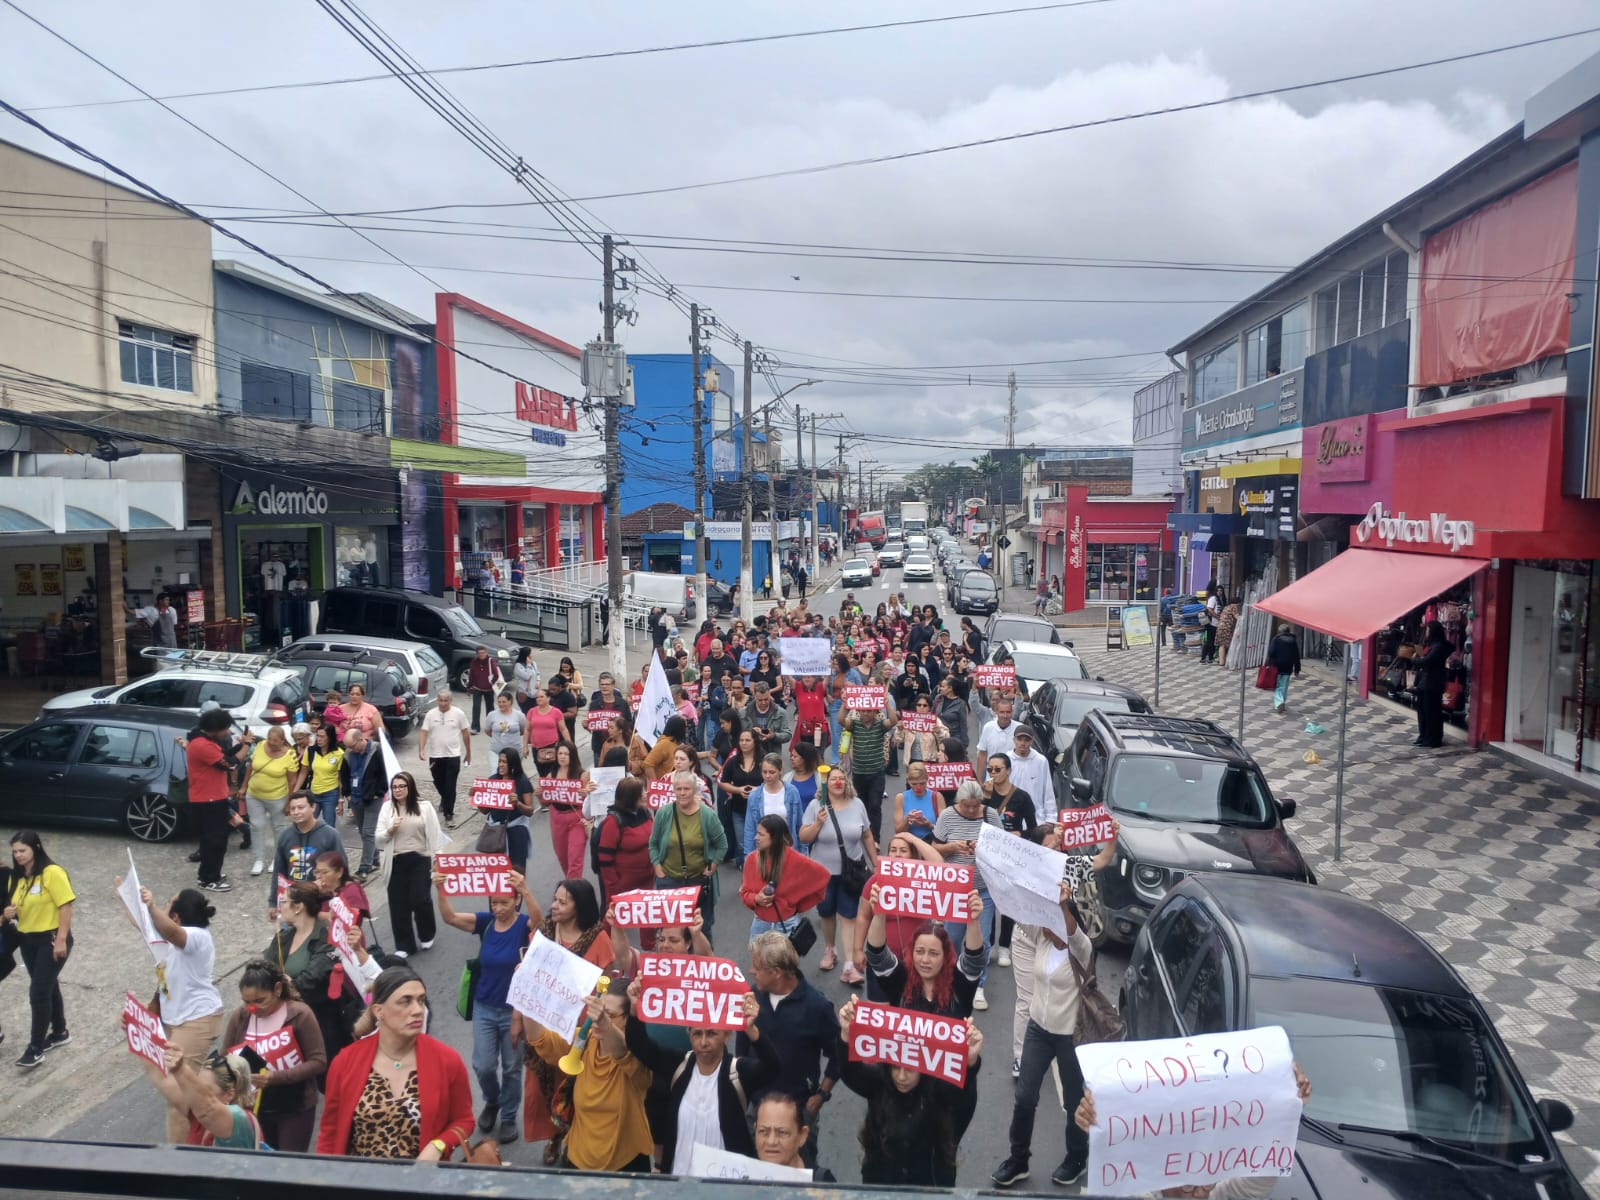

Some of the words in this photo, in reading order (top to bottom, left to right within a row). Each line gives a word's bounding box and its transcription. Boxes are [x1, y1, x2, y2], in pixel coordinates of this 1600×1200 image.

[1200, 476, 1229, 490] CENTRAL
[258, 484, 328, 515] alemão
[846, 686, 884, 694] ESTAMOS
[979, 675, 1013, 686] GREVE
[847, 697, 885, 708] GREVE
[902, 711, 936, 720] ESTAMOS
[925, 763, 970, 773] ESTAMOS
[473, 779, 513, 790] ESTAMOS
[540, 779, 582, 789] ESTAMOS
[1064, 820, 1114, 847] GREVE
[438, 855, 508, 867] ESTAMOS
[880, 860, 970, 884] ESTAMOS
[443, 872, 512, 894] GREVE
[911, 880, 937, 890] EM
[614, 900, 695, 925] GREVE
[878, 885, 969, 919] GREVE
[643, 957, 746, 983] ESTAMOS
[680, 979, 710, 990] EM
[641, 986, 745, 1026] GREVE
[855, 1006, 966, 1044] ESTAMOS
[893, 1033, 925, 1046] EM
[854, 1034, 964, 1081] GREVE
[1242, 1045, 1264, 1074] O
[1107, 1099, 1265, 1148] DINHEIRO
[1102, 1159, 1137, 1187] DA
[1164, 1140, 1293, 1176] EDUCAÇÃO
